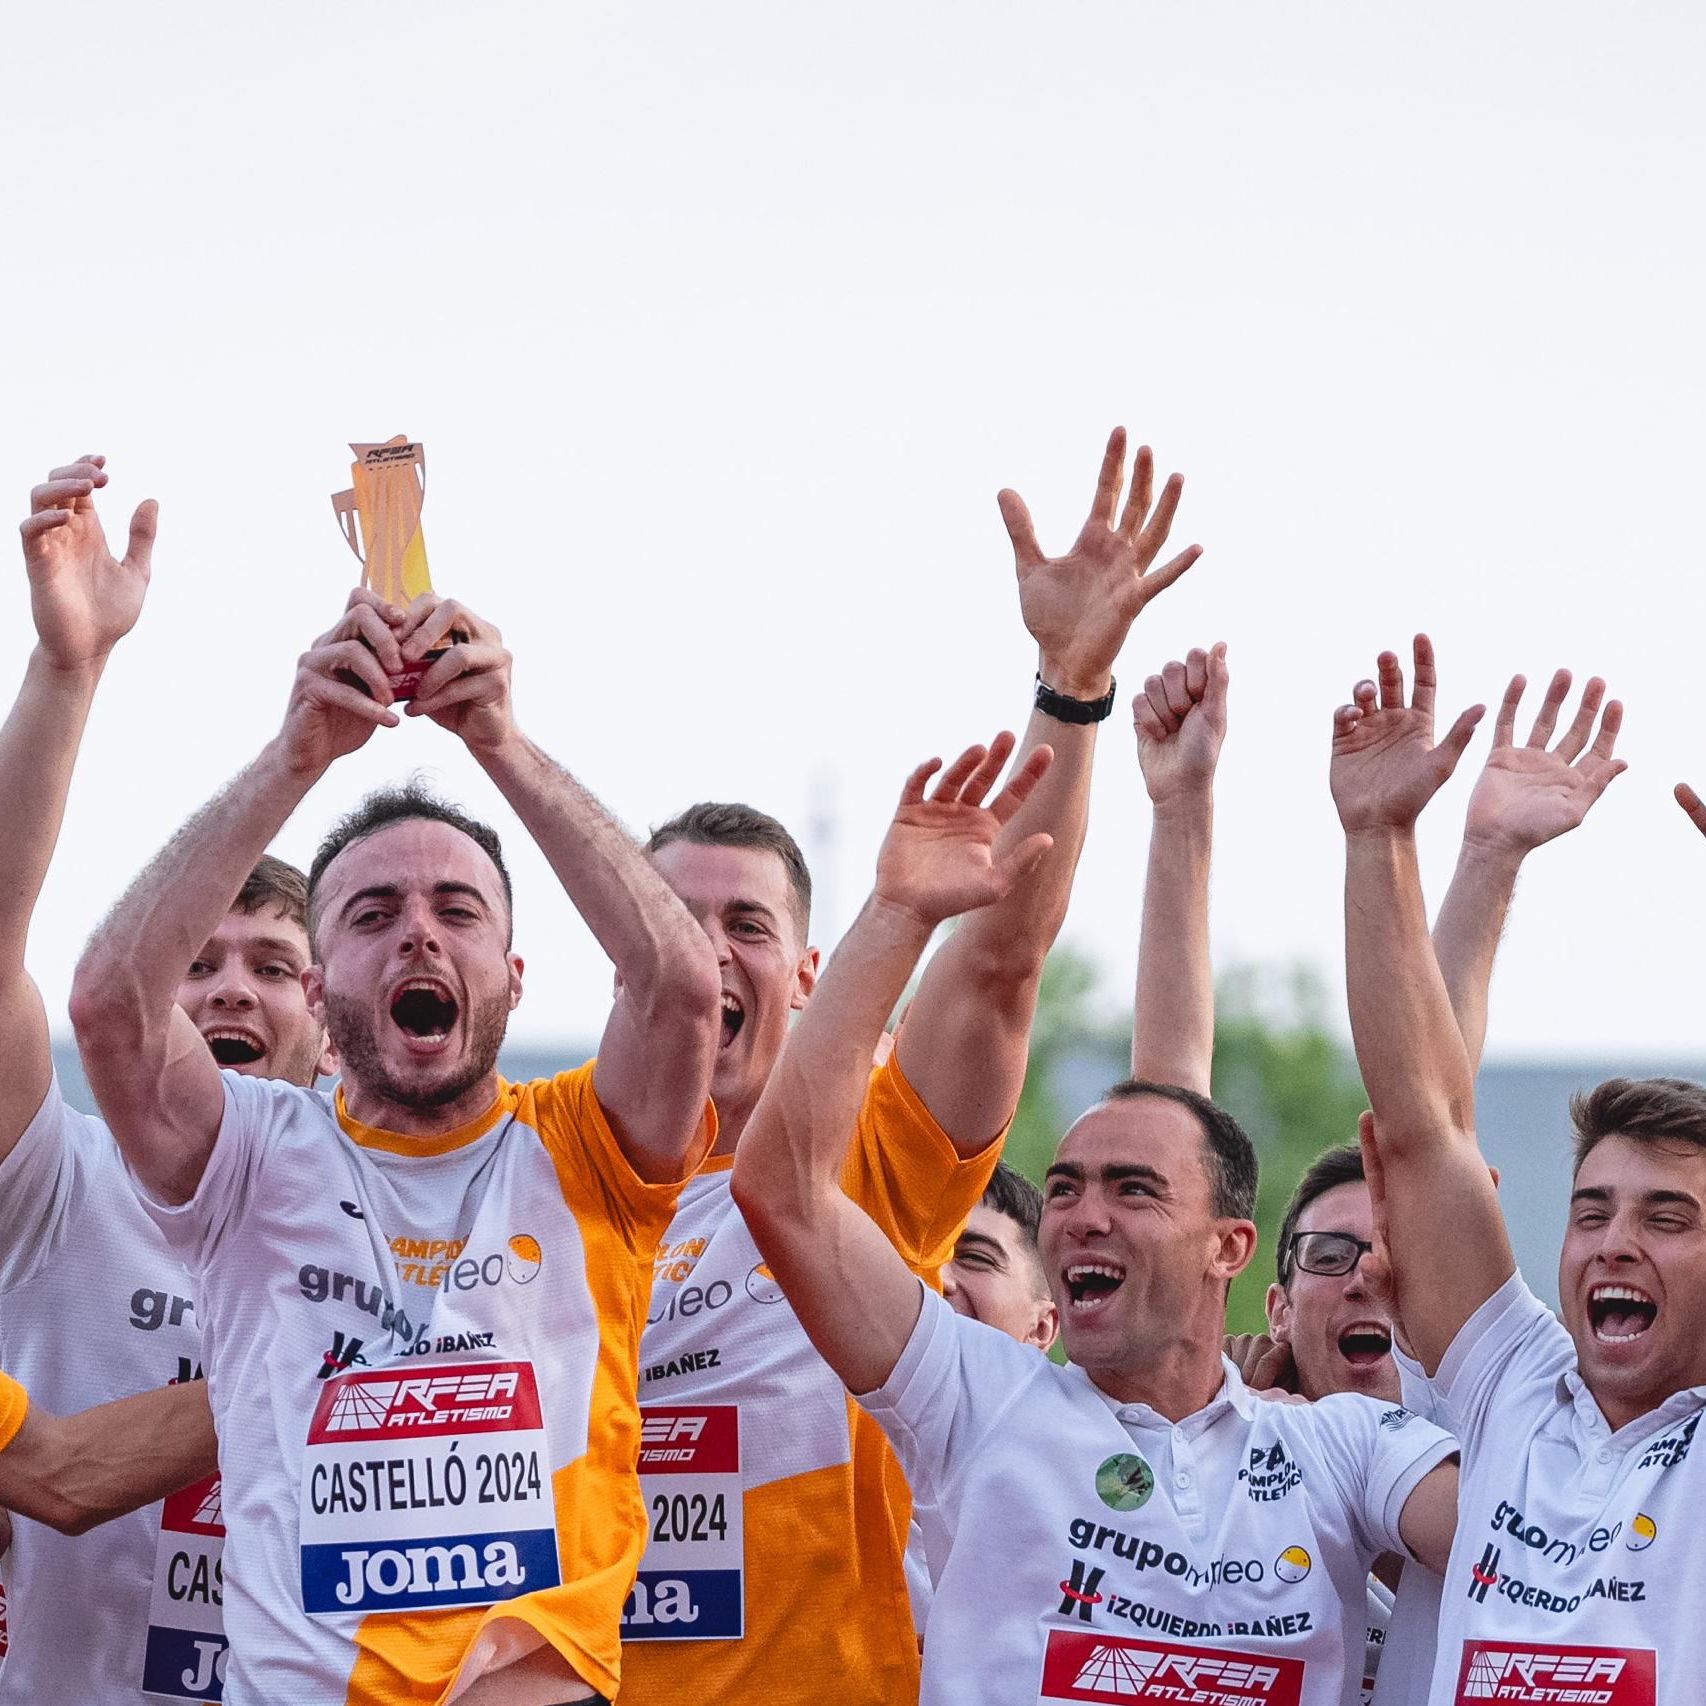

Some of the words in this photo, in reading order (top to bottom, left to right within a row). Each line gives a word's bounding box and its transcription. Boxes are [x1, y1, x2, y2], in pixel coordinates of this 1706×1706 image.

[393, 1371, 519, 1412] RFEA
[387, 1405, 513, 1428] ATLETISMO
[641, 1417, 707, 1442] EA
[311, 1441, 466, 1515] CASTELLÓ
[476, 1450, 541, 1504] 2024
[650, 1493, 727, 1542] 2024
[335, 1539, 525, 1604] Joma
[620, 1579, 699, 1625] ma
[1497, 1573, 1581, 1613] ZQERDO
[1582, 1576, 1646, 1602] AÑEZ
[1155, 1654, 1280, 1692] RFEA
[1503, 1657, 1627, 1687] RFEA
[1496, 1686, 1613, 1705] ATLETISMO
